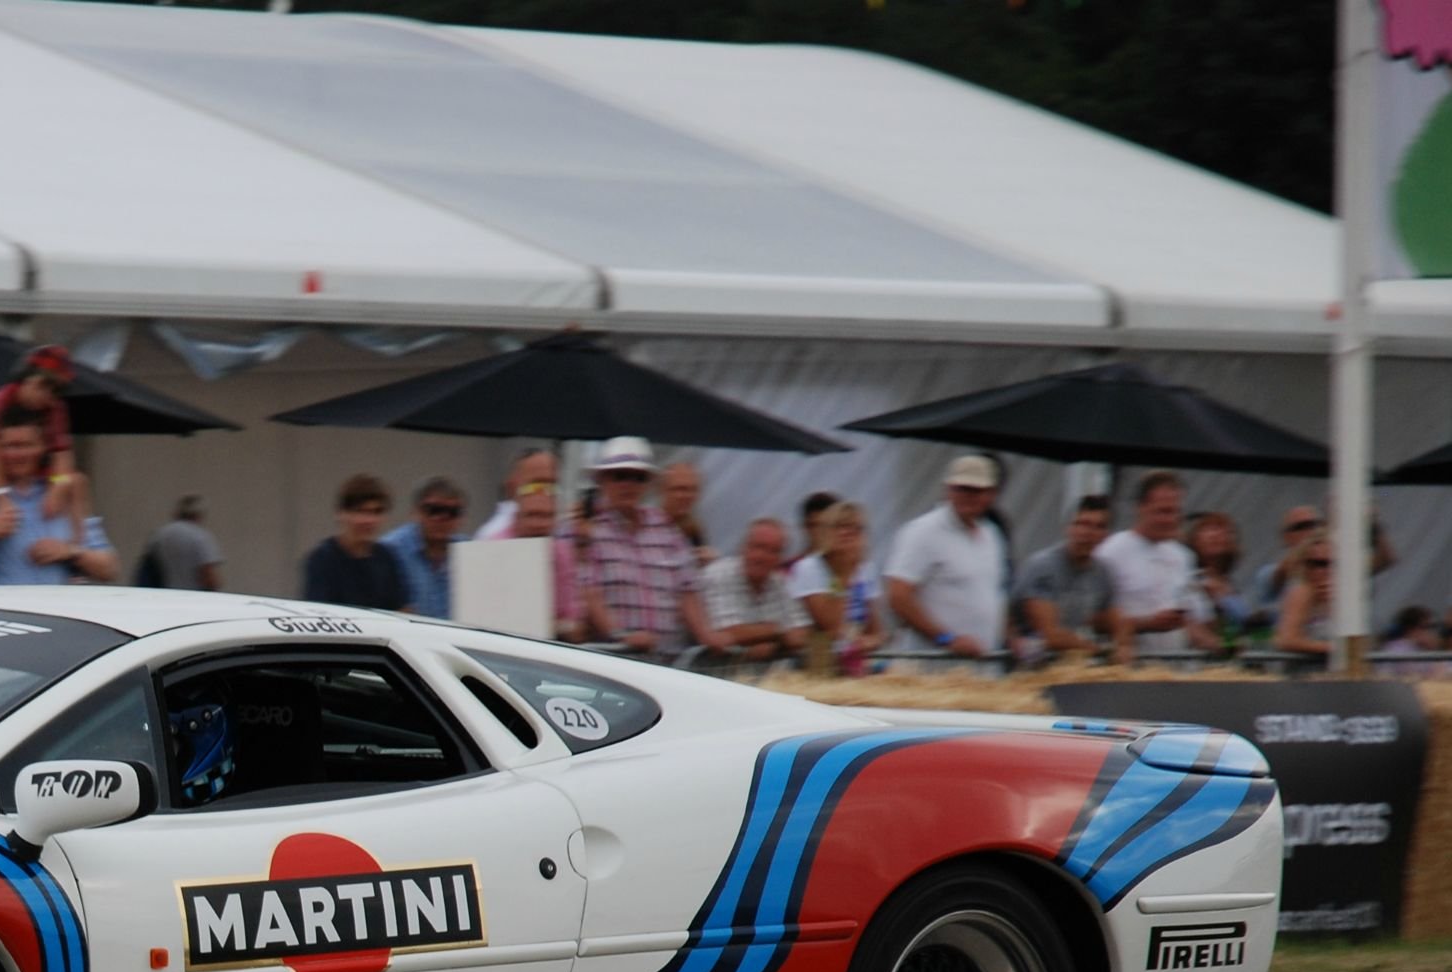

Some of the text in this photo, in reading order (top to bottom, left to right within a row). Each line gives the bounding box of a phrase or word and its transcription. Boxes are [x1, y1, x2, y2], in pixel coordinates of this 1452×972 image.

[268, 616, 363, 633] Giudici
[554, 706, 598, 729] 220
[193, 874, 472, 954] MARTINI
[1146, 921, 1247, 971] PIRELLI
